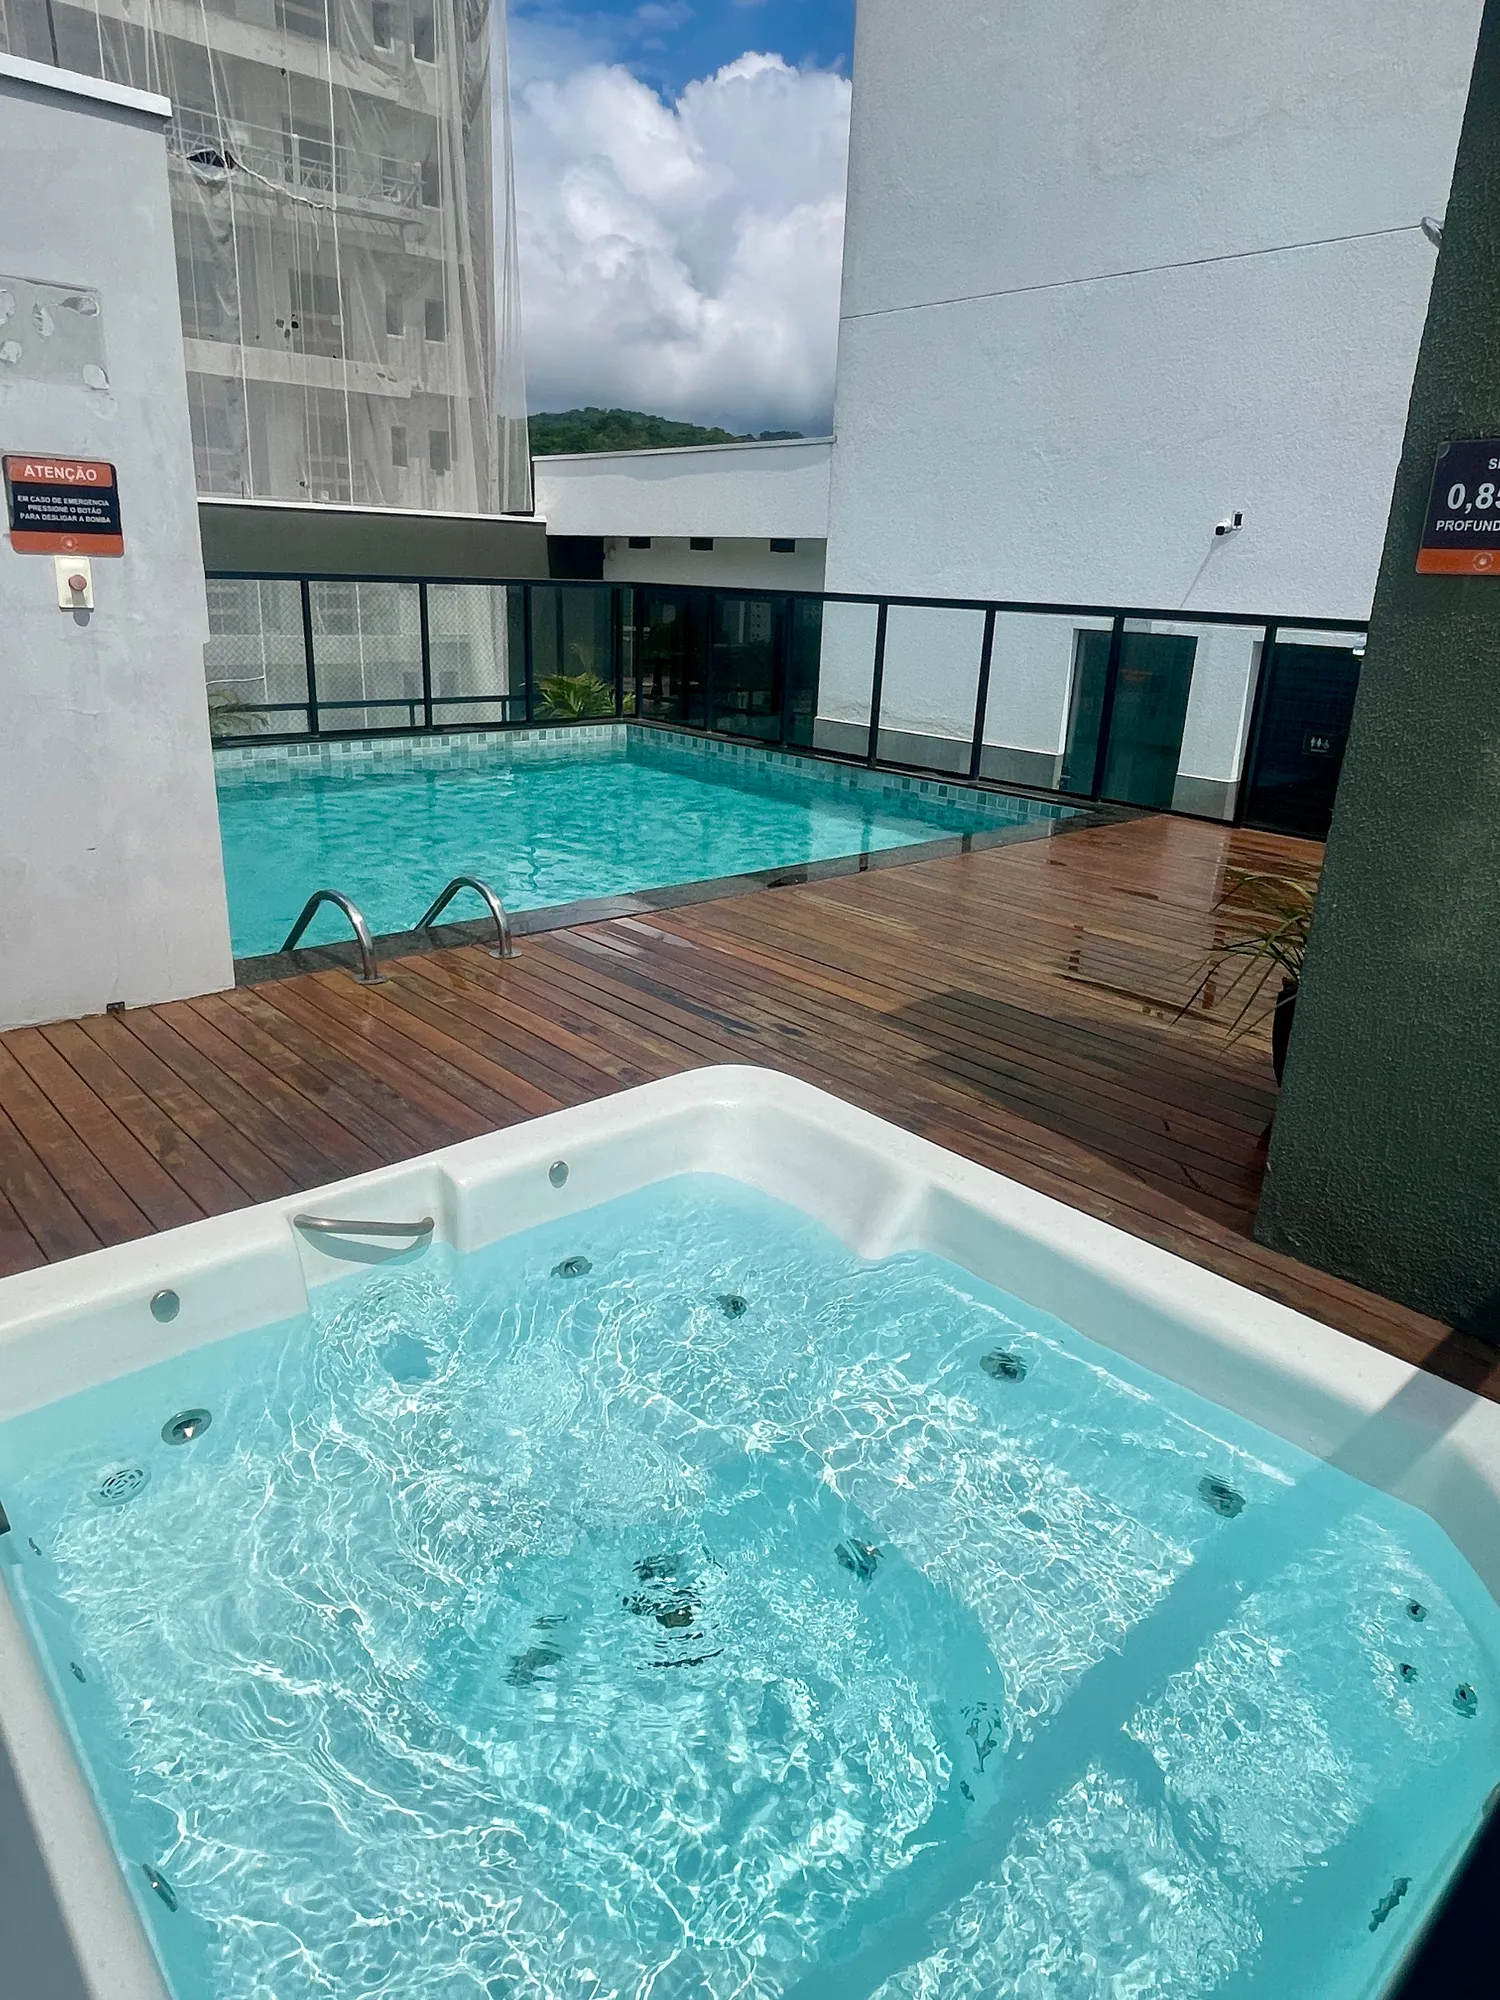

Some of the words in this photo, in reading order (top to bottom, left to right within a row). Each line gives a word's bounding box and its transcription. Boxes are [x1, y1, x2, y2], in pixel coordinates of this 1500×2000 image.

[24, 464, 97, 483] ATENÇÃO
[28, 504, 69, 513] PRESSIONE
[76, 506, 102, 514] BOTÃO
[20, 512, 41, 520] PARA
[42, 514, 78, 522] DESLIGAR
